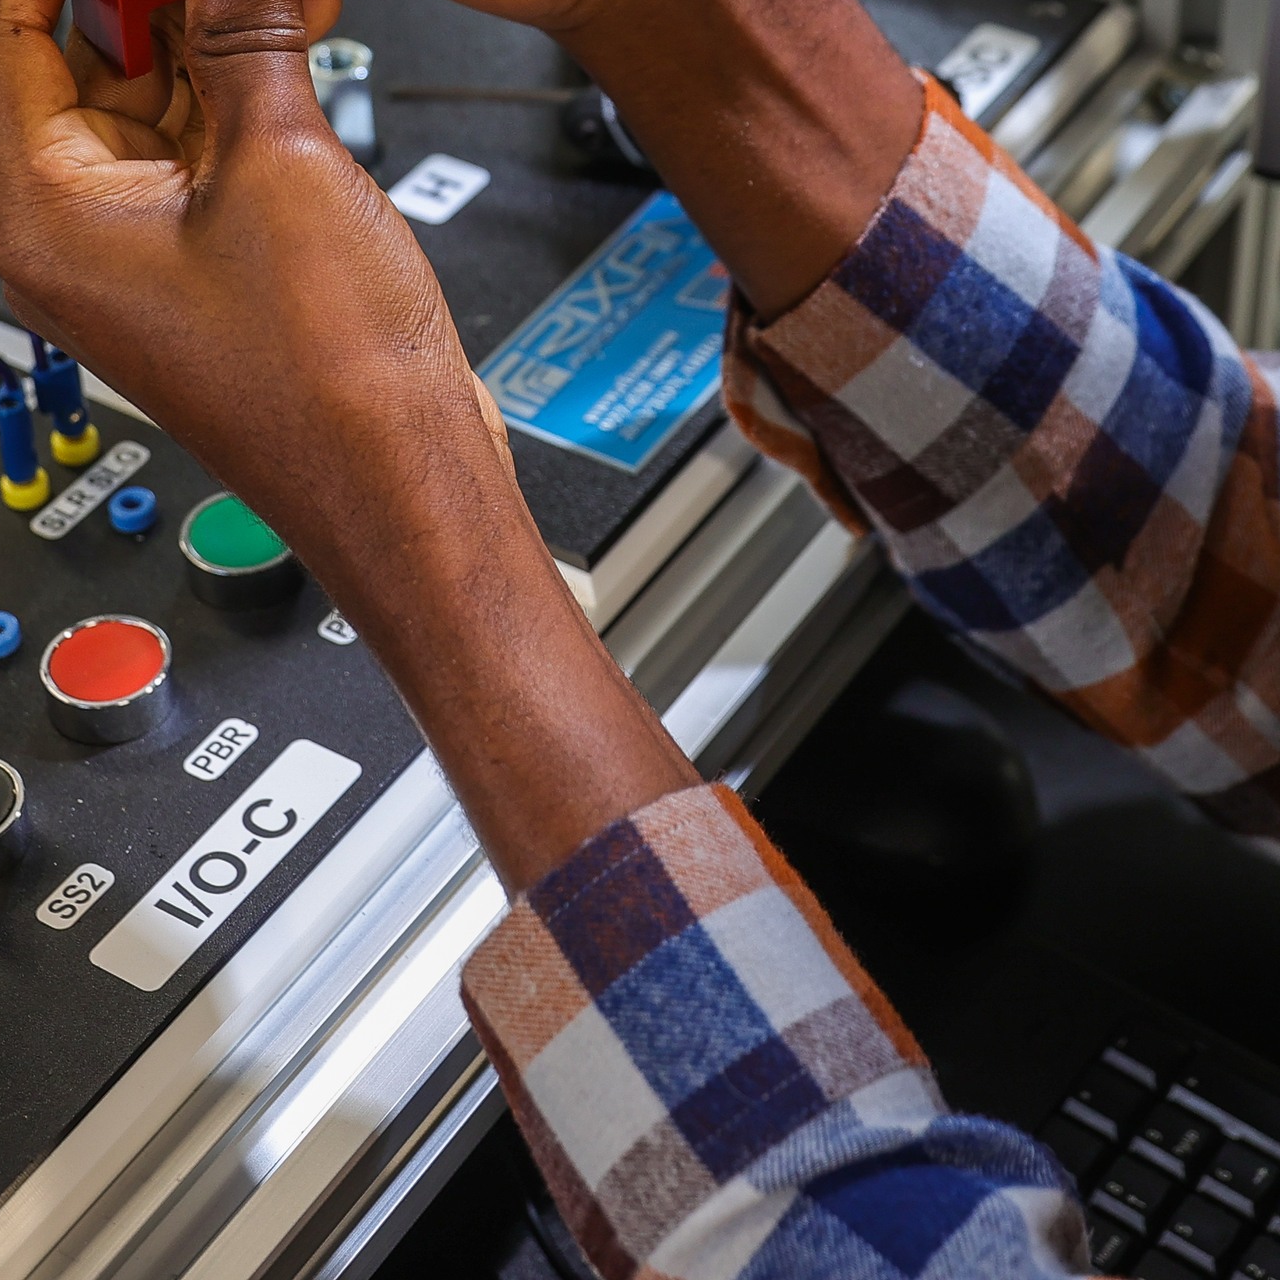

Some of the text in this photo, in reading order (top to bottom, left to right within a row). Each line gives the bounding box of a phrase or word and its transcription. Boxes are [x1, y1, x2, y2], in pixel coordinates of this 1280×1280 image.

[191, 724, 251, 775] PBR
[153, 798, 298, 929] I/O-C
[48, 871, 107, 920] SS2
